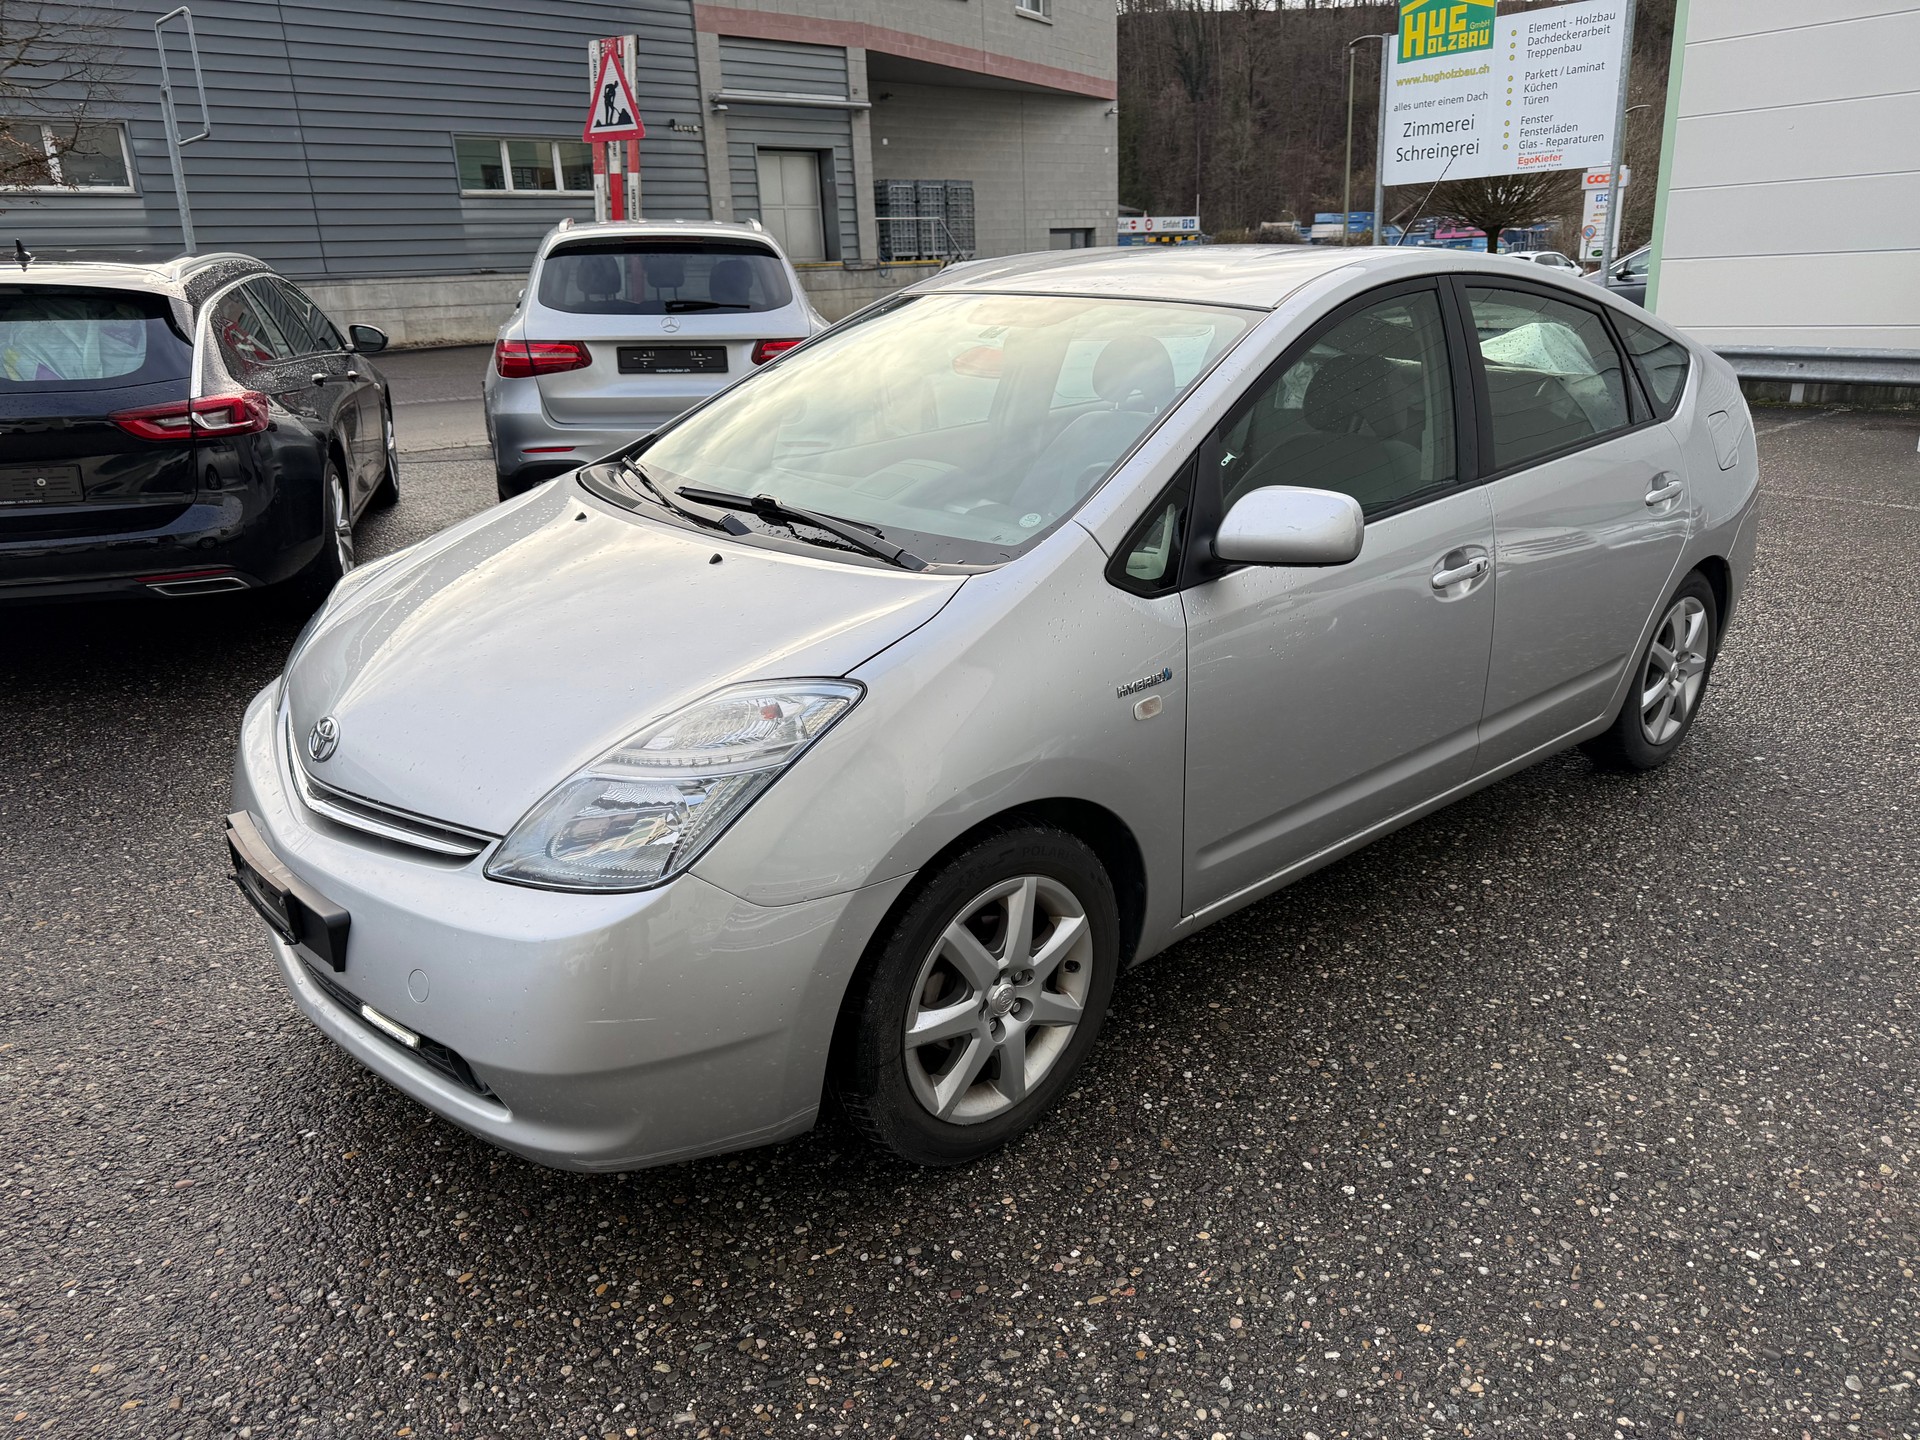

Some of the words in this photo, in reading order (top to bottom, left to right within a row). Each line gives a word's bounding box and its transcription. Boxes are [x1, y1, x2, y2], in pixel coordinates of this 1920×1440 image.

[1403, 4, 1468, 58] HUG
[1469, 19, 1491, 30] GmbH
[1528, 19, 1567, 33] Element
[1575, 12, 1616, 26] Holzbau
[1527, 24, 1611, 46] Dachdeckerarbeit
[1526, 43, 1582, 59] Treppenbau
[1396, 64, 1490, 86] www.hugholzbau.ch
[1524, 68, 1558, 80] Parkett
[1566, 61, 1605, 75] Laminat
[1523, 81, 1558, 93] Küchen
[1393, 102, 1412, 112] alles
[1413, 99, 1436, 109] unter
[1437, 96, 1464, 106] einem
[1466, 91, 1489, 102] Dach
[1523, 95, 1549, 105] Türen
[1403, 113, 1475, 137] Zimmerei
[1520, 114, 1554, 125] Fenster
[1519, 123, 1579, 137] Fensterläden
[1395, 138, 1480, 162] Schreinerei
[1518, 139, 1538, 149] Glas
[1545, 133, 1605, 147] Reparaturen
[1517, 154, 1563, 166] EgoKiefer
[1116, 672, 1166, 698] HYBRID
